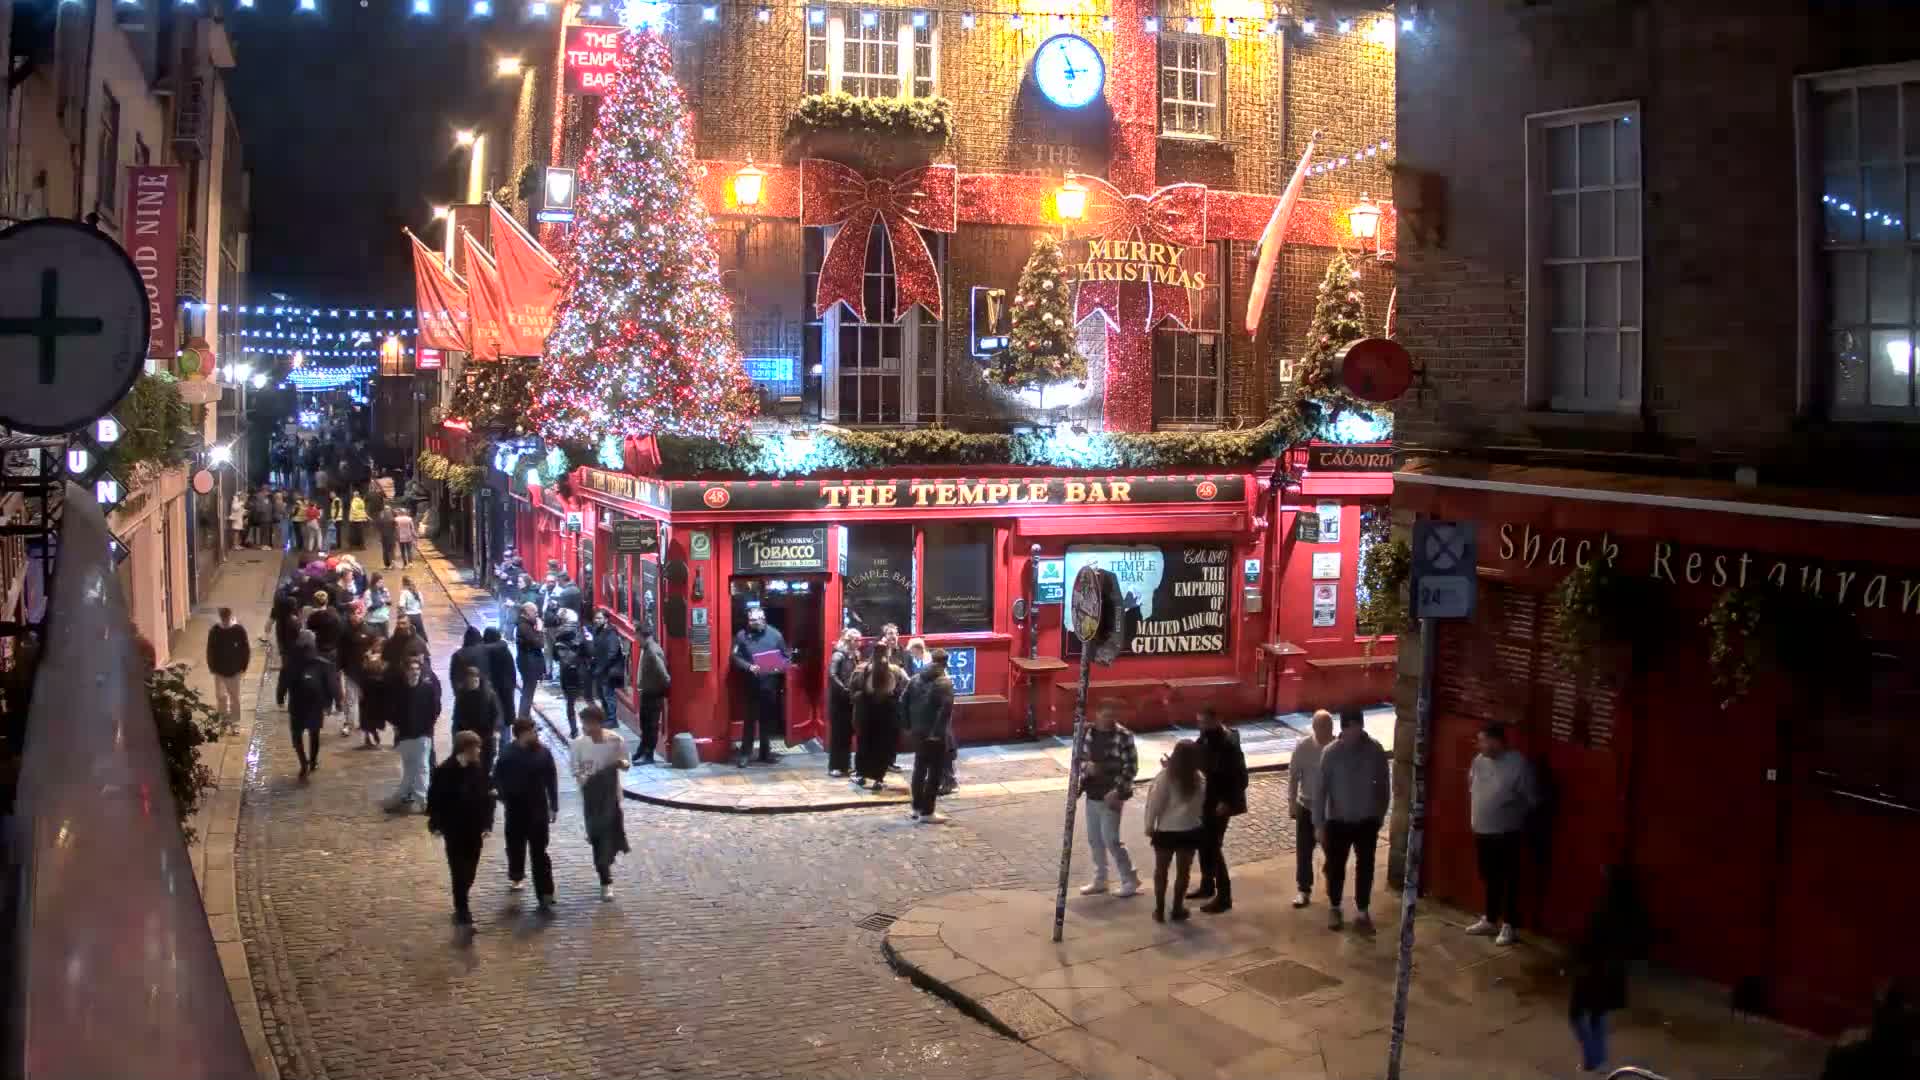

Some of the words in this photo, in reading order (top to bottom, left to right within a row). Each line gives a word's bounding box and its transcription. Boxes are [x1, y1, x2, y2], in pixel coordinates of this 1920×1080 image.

[584, 32, 617, 48] THE
[1032, 144, 1081, 166] THE
[136, 174, 168, 235] NINE
[1088, 240, 1185, 267] MERRY
[1063, 262, 1207, 291] CHRISTMAS
[822, 484, 897, 507] THE
[911, 481, 1049, 506] TEMPLE
[1064, 480, 1132, 503] BAR
[748, 542, 815, 565] TOBACCO
[1122, 551, 1144, 561] THE
[1498, 522, 1620, 569] Shack
[1110, 560, 1157, 572] TEMPLE
[1120, 571, 1144, 582] BAR
[1202, 567, 1225, 581] THE
[846, 569, 889, 592] TEMPLE
[1174, 582, 1225, 597] EMPEROR
[1210, 597, 1223, 610] OF
[1136, 619, 1180, 636] MALTED
[1181, 612, 1225, 632] LIQUORS
[1131, 634, 1223, 654] GUINNESS
